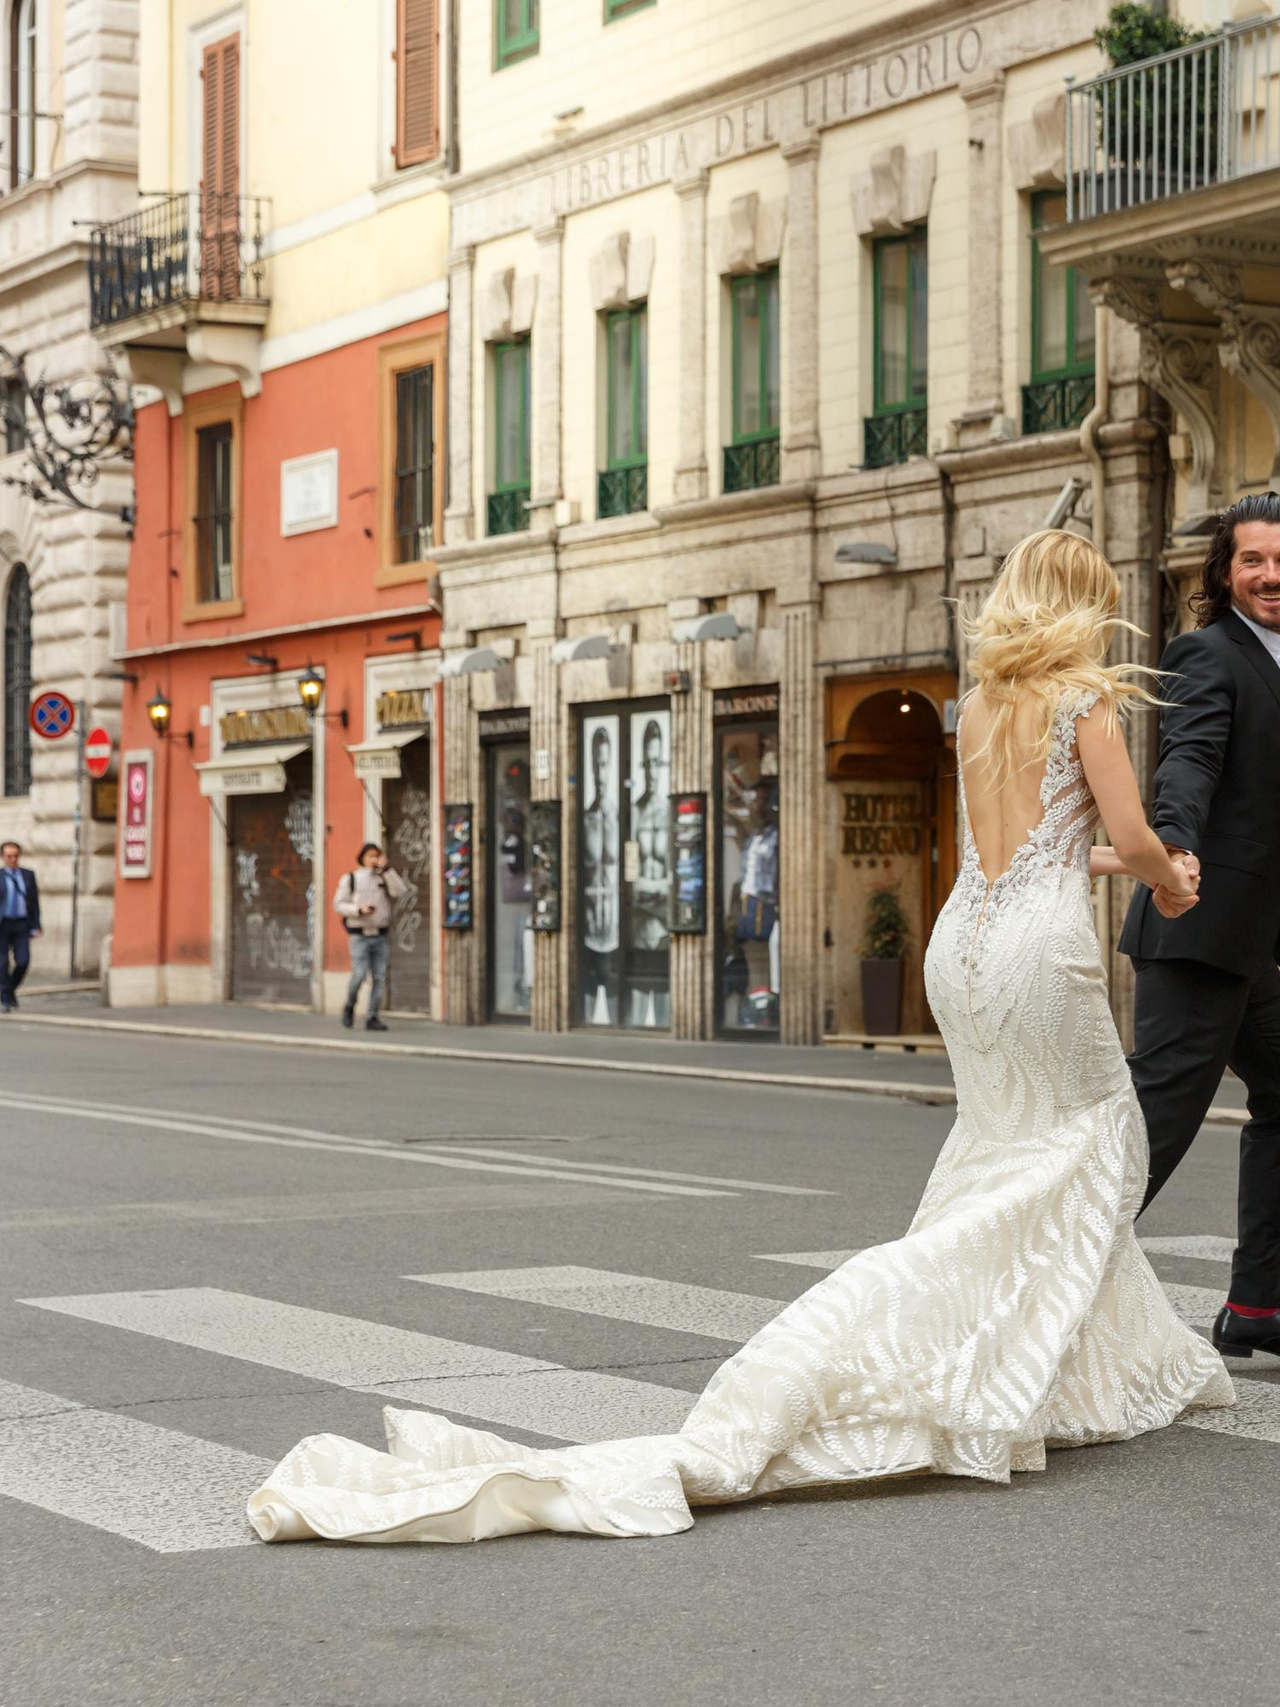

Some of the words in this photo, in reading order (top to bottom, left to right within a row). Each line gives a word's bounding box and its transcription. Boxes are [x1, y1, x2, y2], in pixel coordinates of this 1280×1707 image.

[550, 131, 690, 213] LIBRERIA
[716, 100, 774, 158] DEL
[803, 25, 984, 129] LITTORIO
[843, 793, 919, 823] HOTEL
[842, 826, 920, 856] REGNO
